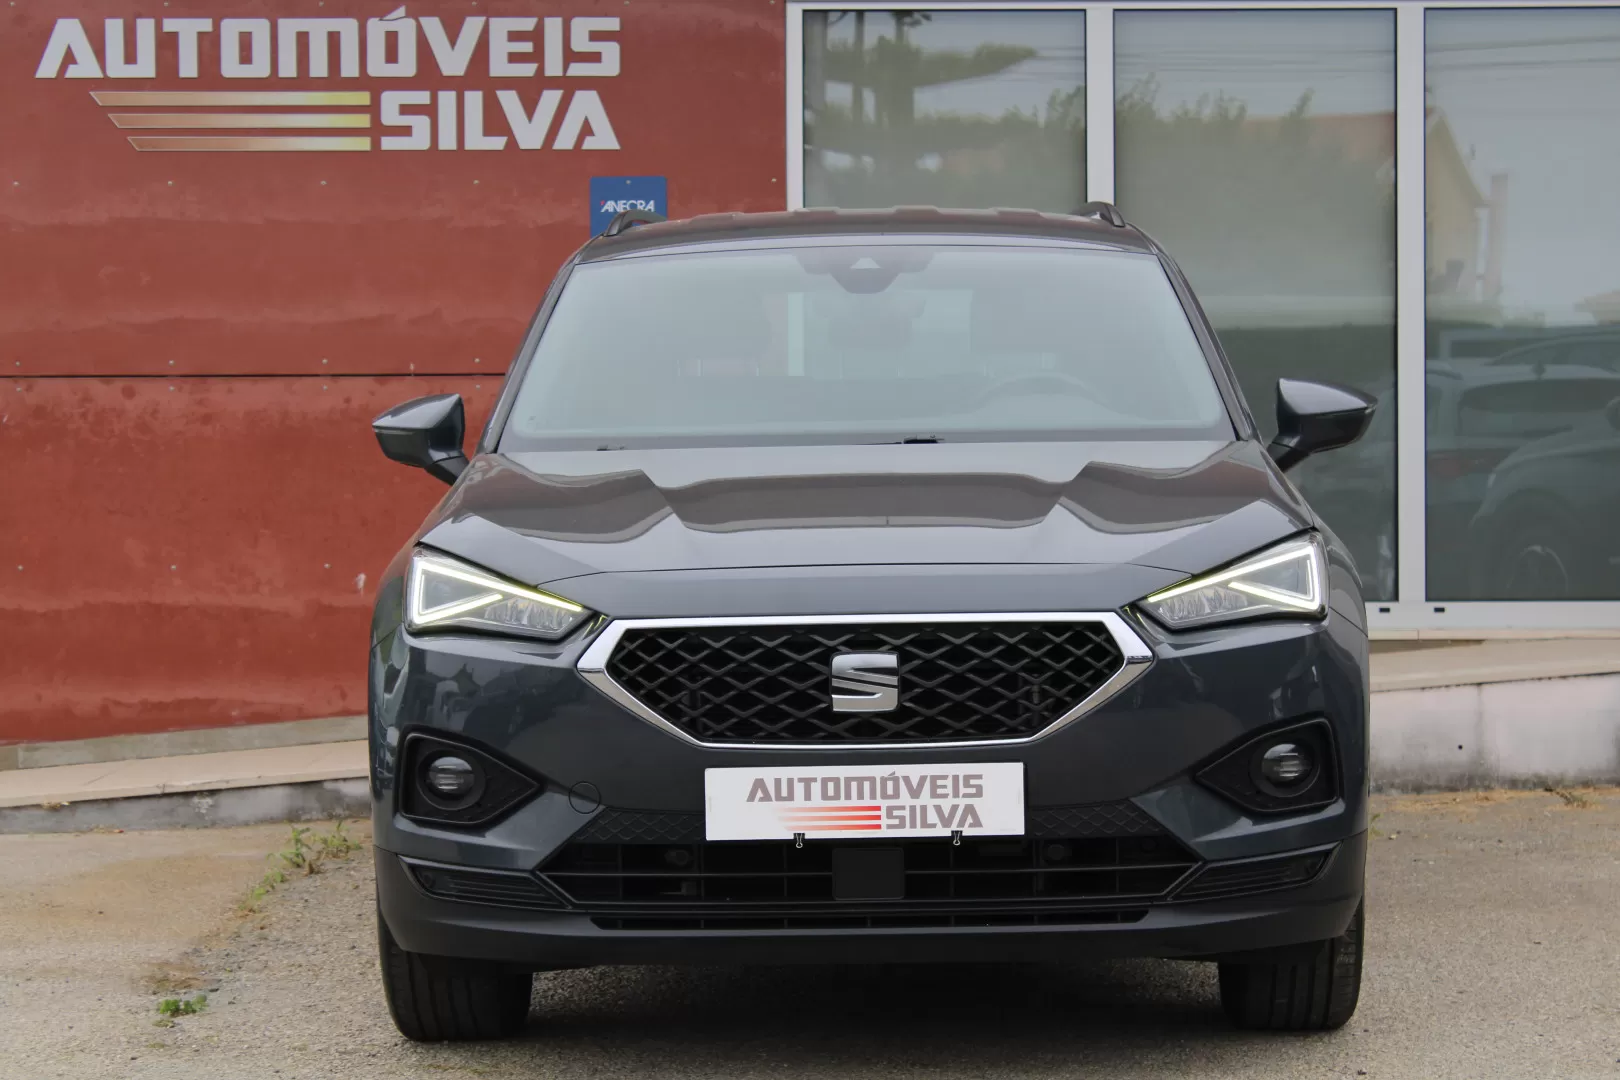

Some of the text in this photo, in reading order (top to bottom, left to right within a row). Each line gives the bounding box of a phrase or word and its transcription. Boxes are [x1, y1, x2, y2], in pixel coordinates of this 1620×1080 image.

[35, 6, 621, 79] AUTOMÓVEIS
[380, 90, 621, 150] SILVA
[746, 771, 984, 803] AUTOMÓVEIS
[885, 804, 984, 830] SILVA
